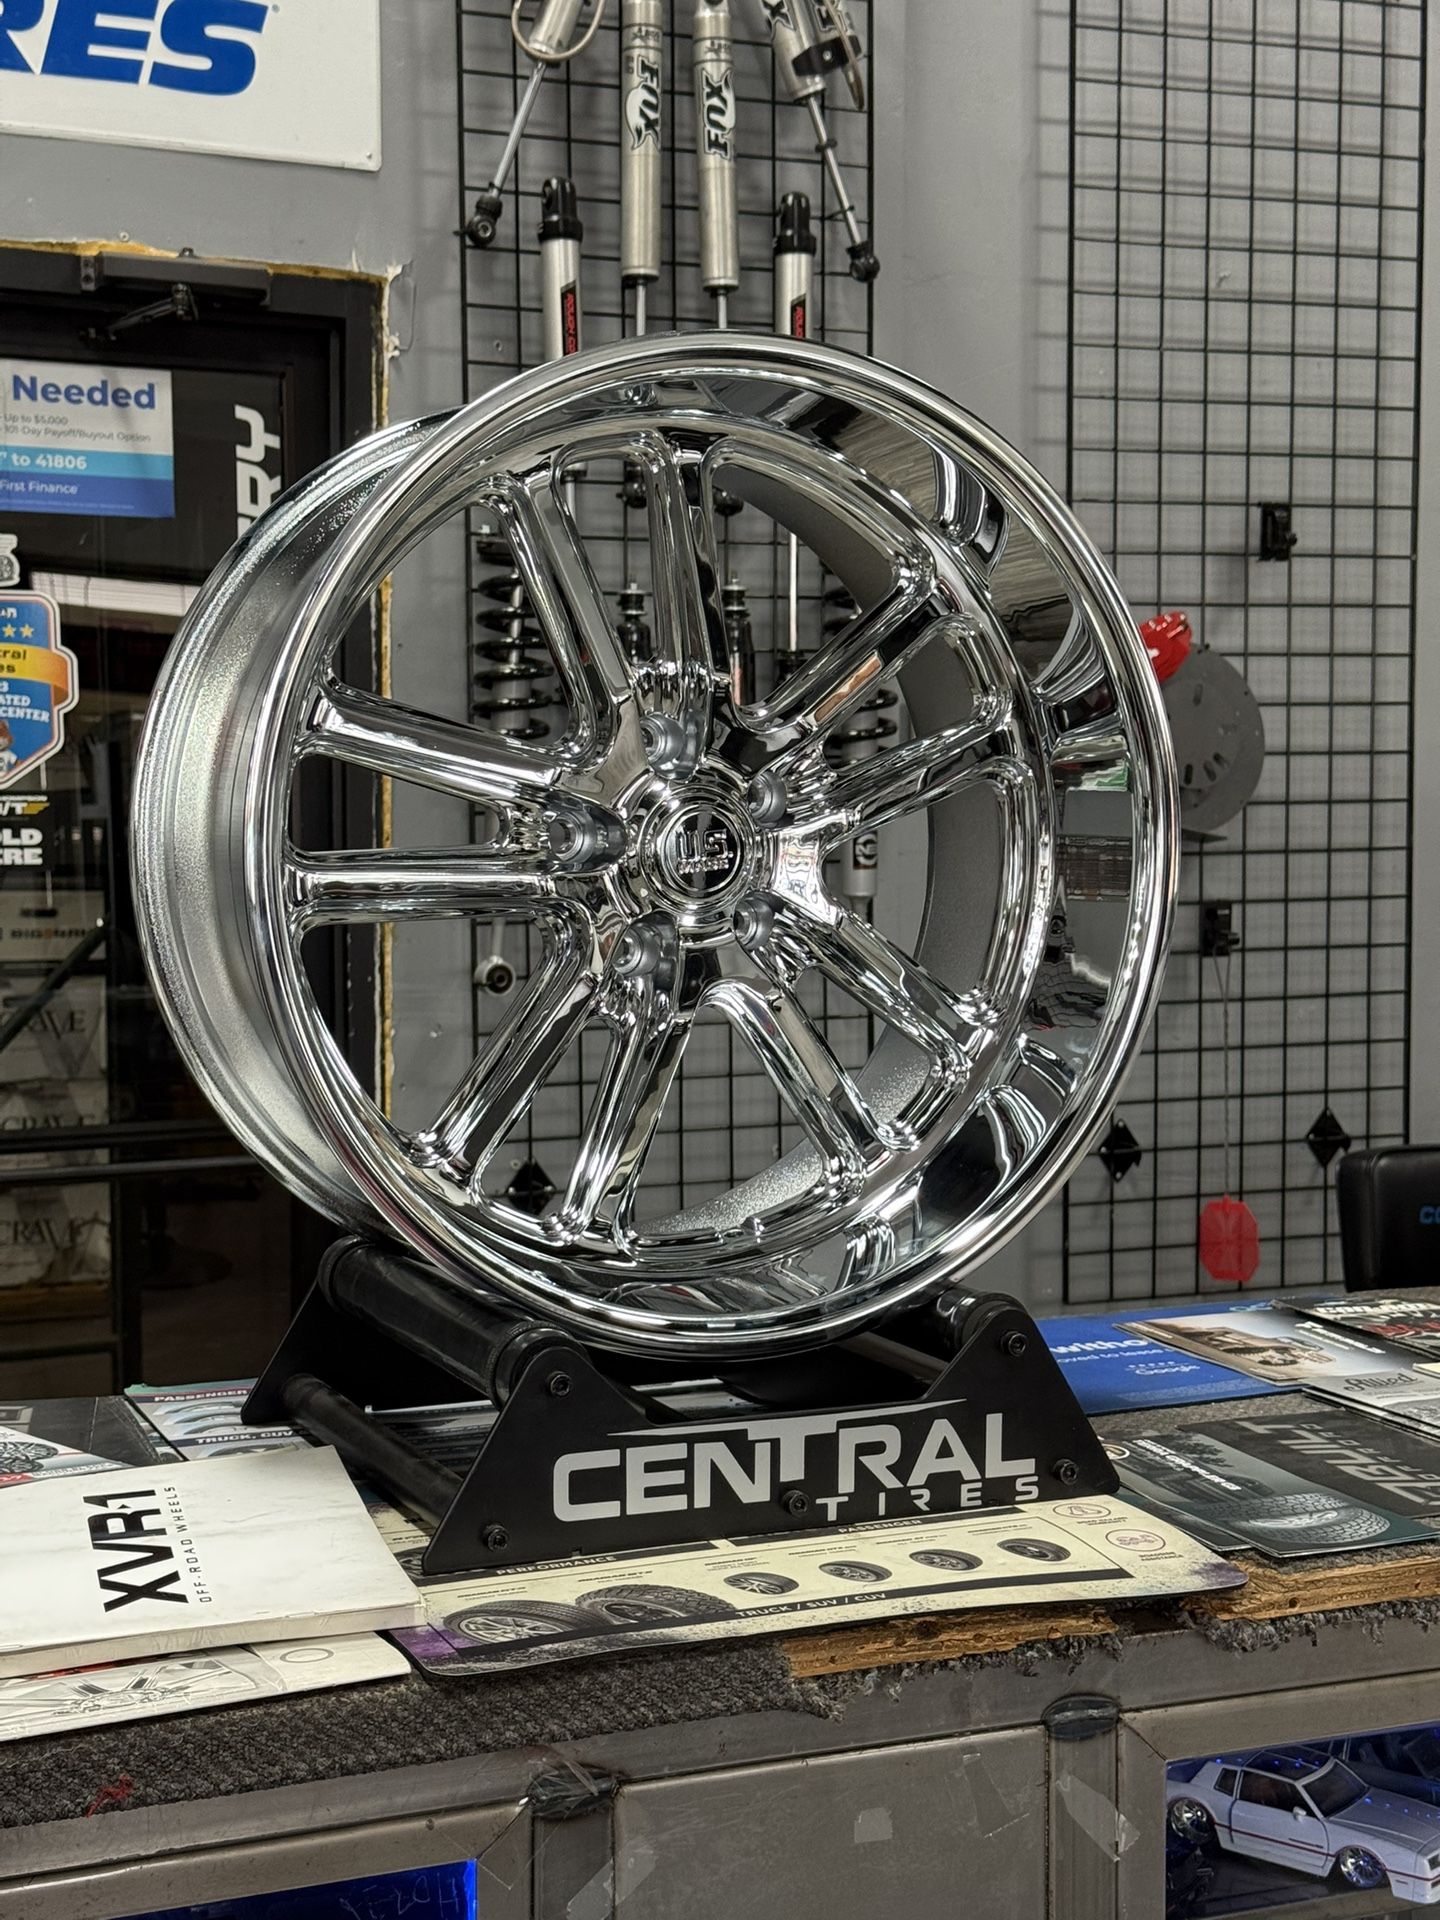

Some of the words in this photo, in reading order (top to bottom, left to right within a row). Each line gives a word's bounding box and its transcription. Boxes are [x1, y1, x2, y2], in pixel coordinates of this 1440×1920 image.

[630, 56, 660, 150] FOX
[703, 69, 735, 159] FOX
[12, 374, 156, 410] Needed
[4, 413, 18, 424] Up
[20, 415, 32, 424] to
[117, 429, 151, 443] Option
[11, 452, 31, 467] to
[35, 455, 88, 470] 41806
[28, 481, 79, 495] Finance
[0, 827, 43, 847] LD
[0, 847, 43, 866] RE
[1050, 1339, 1149, 1353] witho
[1134, 1363, 1200, 1375] Google
[154, 1388, 248, 1402] PASSENGER
[259, 1429, 293, 1438] CUV
[553, 1408, 1035, 1522] CENTRAL
[816, 1475, 1039, 1521] TIRES
[163, 1486, 188, 1533] WHEELS
[838, 1518, 922, 1534] PASSENGER
[181, 1538, 213, 1603] OFF-ROAD
[496, 1555, 618, 1576] PERFORMANCE
[735, 1605, 794, 1618] TRUCK
[805, 1599, 838, 1609] SUV
[854, 1590, 887, 1602] CUV
